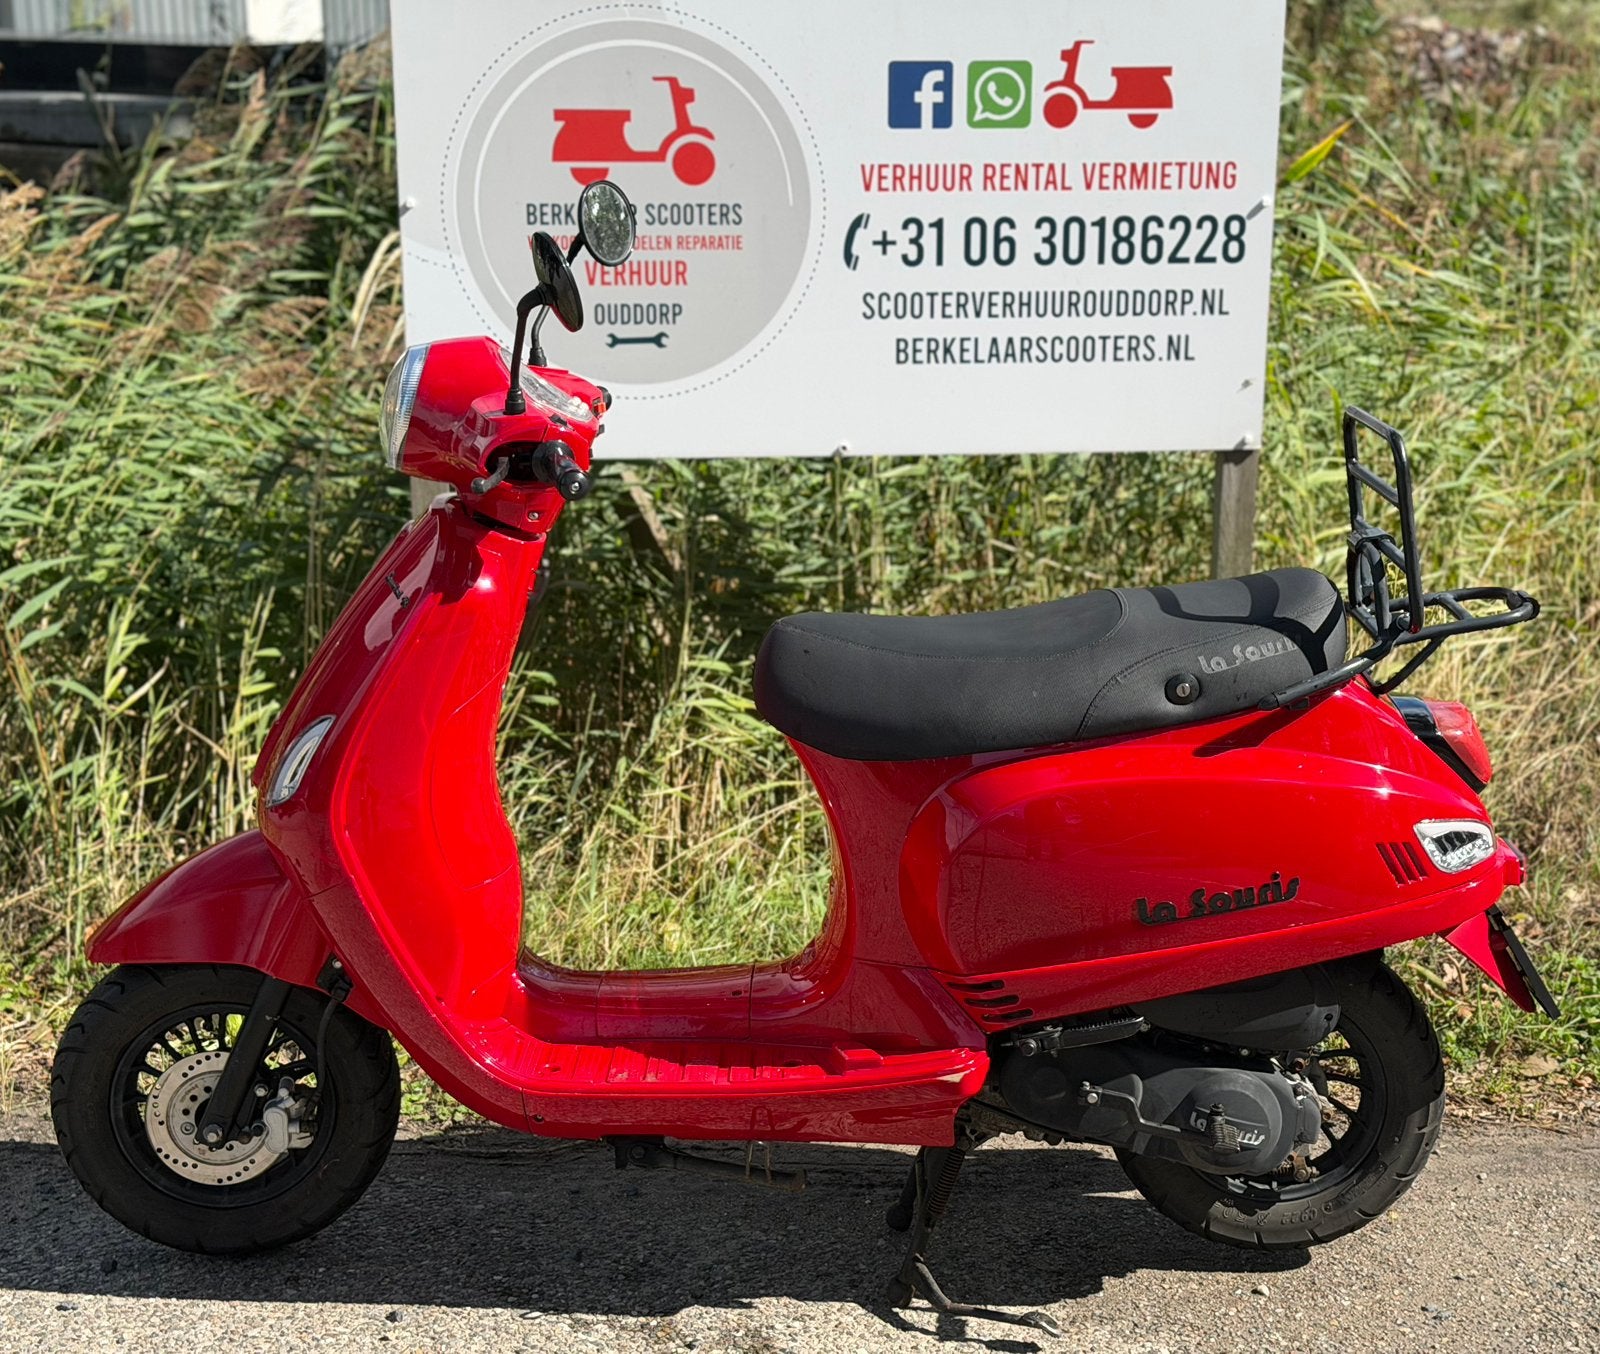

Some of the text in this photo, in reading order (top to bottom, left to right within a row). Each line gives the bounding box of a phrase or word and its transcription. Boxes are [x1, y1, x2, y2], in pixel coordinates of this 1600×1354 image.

[861, 161, 1238, 192] VERHUUR RENTAL VERMIETUNG
[526, 203, 743, 226] BERKR SCOOTERS
[677, 235, 743, 250] REPARATIE
[872, 214, 1247, 267] +31 06 30186228
[585, 260, 688, 286] VERHUUR
[594, 303, 682, 325] OUDDORP
[862, 289, 1230, 320] SCOOTERVERHUUROUDDORP.NL
[896, 335, 1195, 364] BERKELAARSCOOTERS.NL
[1191, 870, 1300, 918] Souris
